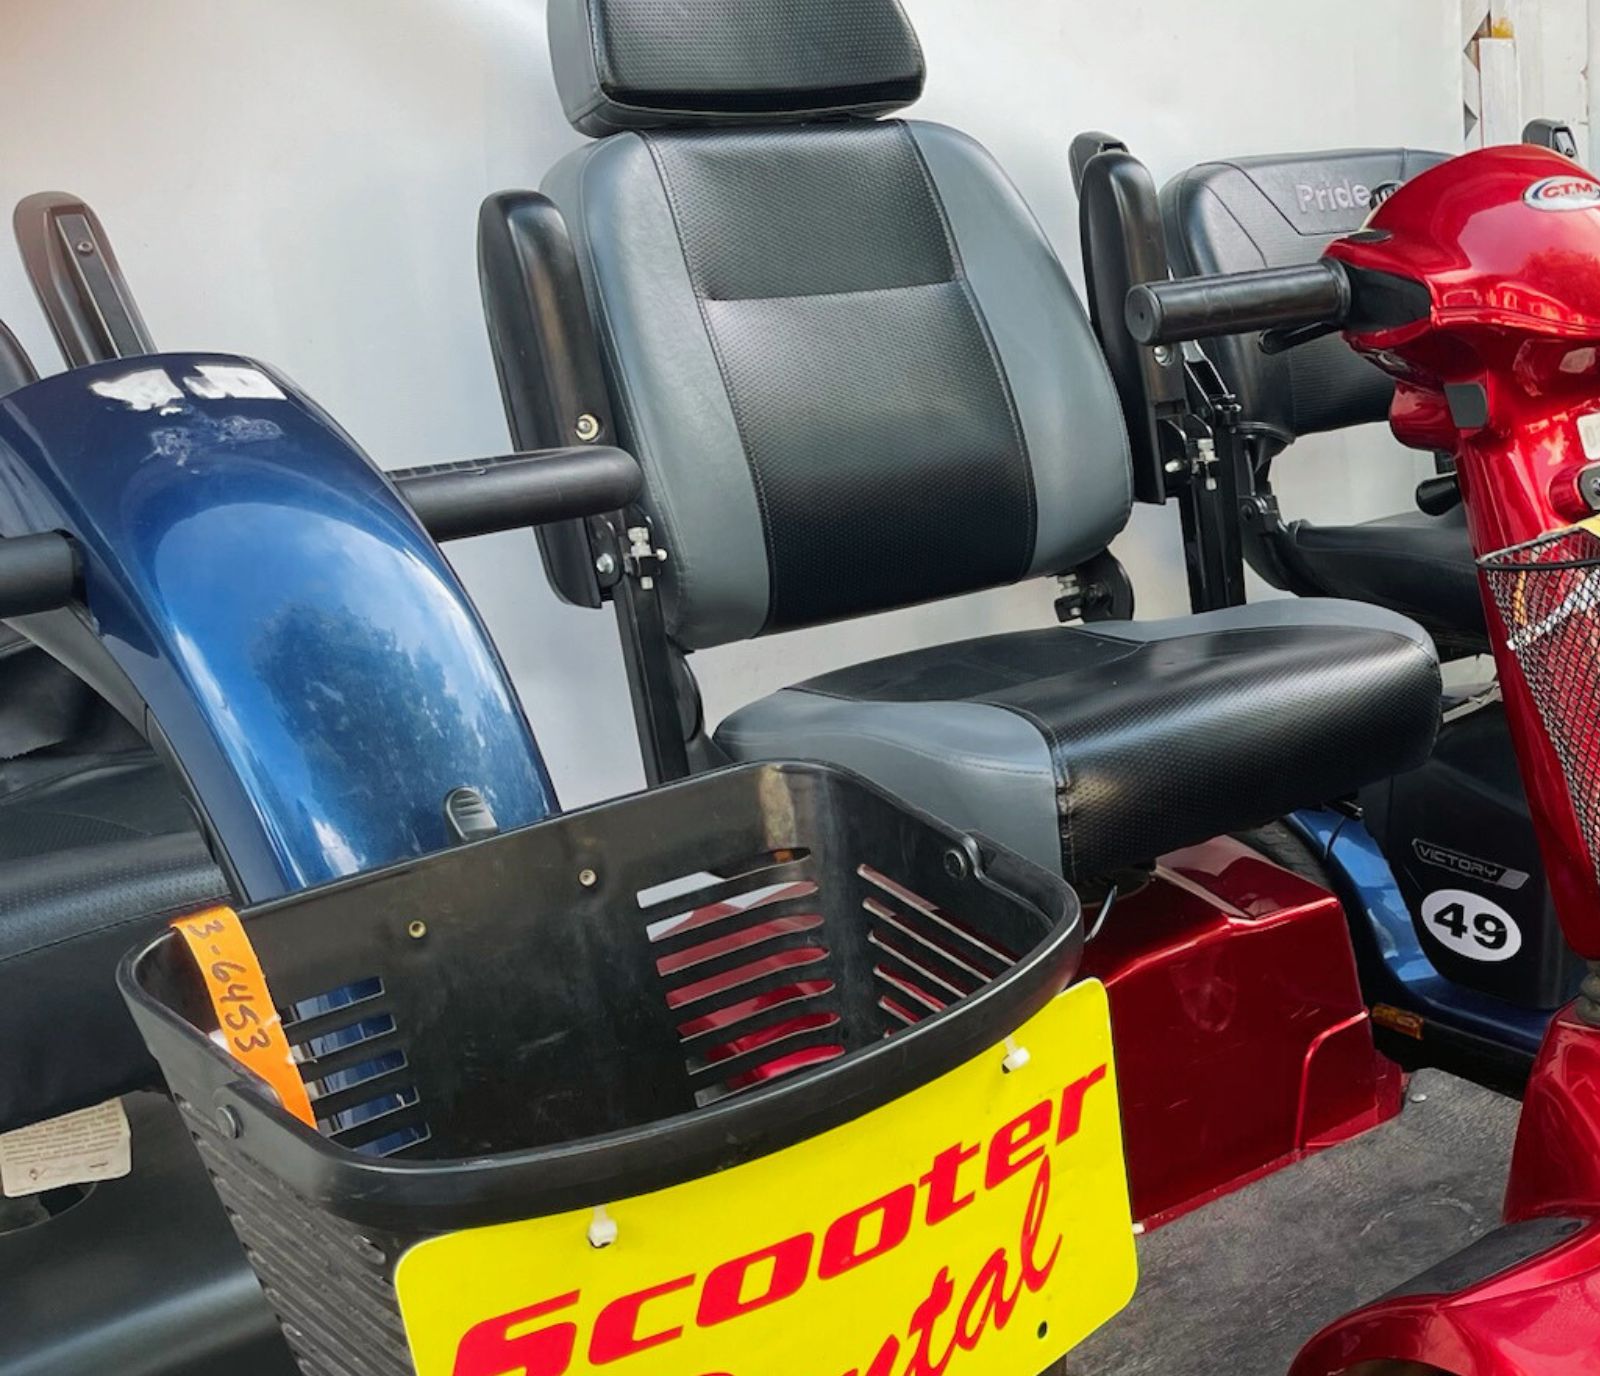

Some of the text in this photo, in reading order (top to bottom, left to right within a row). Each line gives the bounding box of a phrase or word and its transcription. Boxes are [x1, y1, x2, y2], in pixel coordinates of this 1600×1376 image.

[1295, 179, 1371, 214] Pride
[1419, 844, 1498, 878] VICTORY
[1434, 902, 1508, 950] 49
[188, 919, 272, 1053] 3-6453
[452, 1063, 1107, 1376] Scooter
